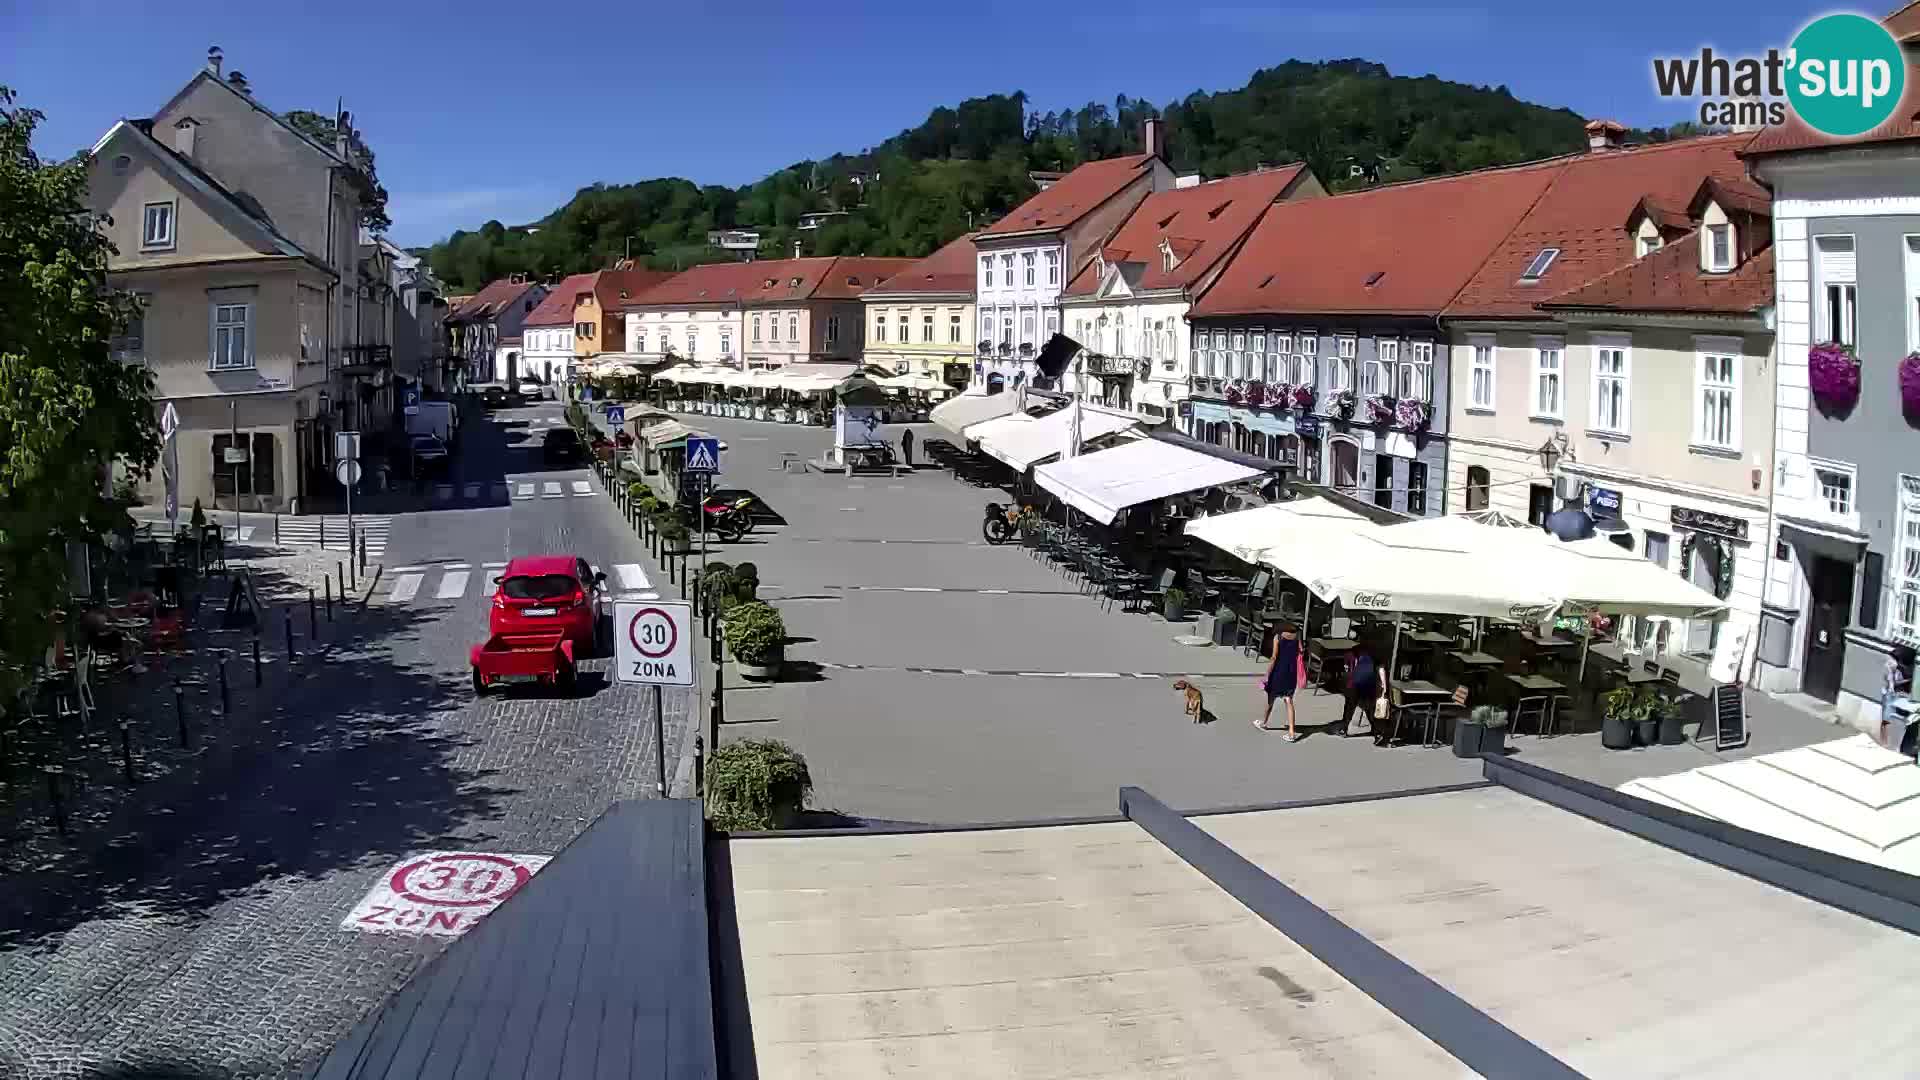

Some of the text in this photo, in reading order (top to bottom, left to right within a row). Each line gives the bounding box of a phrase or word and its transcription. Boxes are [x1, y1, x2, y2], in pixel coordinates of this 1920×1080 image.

[642, 624, 665, 645] 30
[632, 661, 677, 678] ZONA
[418, 866, 503, 894] 30
